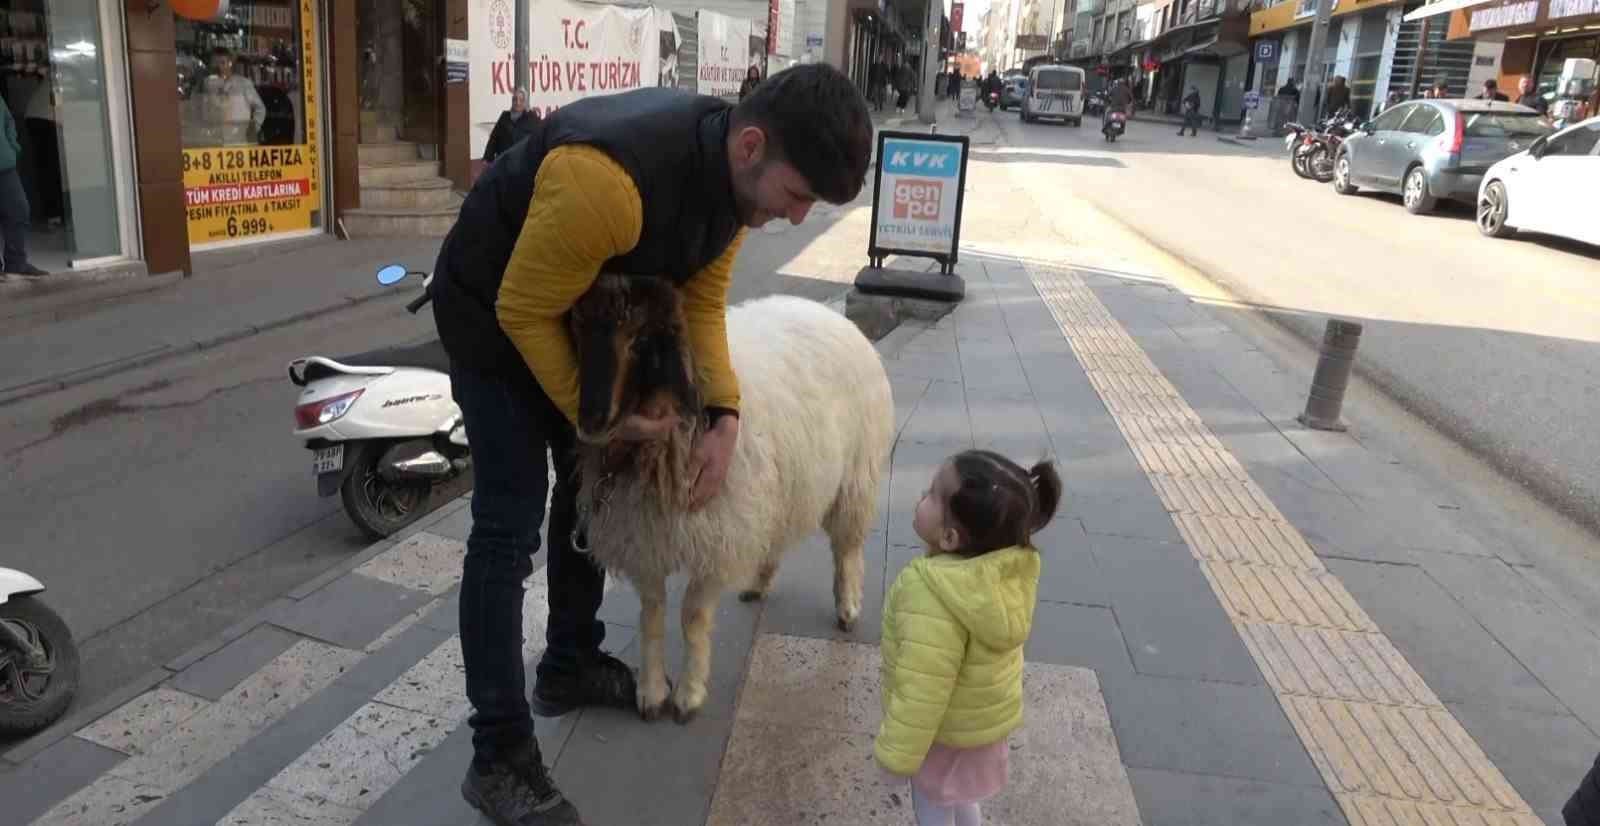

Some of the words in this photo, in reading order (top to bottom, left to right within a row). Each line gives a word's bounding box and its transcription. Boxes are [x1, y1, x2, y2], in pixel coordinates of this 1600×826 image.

[561, 19, 589, 49] T.C.
[491, 53, 562, 95] KÜTÜR
[566, 61, 586, 92] VE
[590, 56, 641, 90] TURİZM
[217, 151, 245, 170] 128
[248, 148, 303, 168] HAFIZA
[890, 151, 950, 168] KVK
[209, 173, 240, 184] AKILLI
[242, 170, 282, 182] TELEFON
[186, 187, 209, 204] TÜM
[211, 185, 241, 202] KREDİ
[243, 182, 302, 200] KARTLARINA
[895, 184, 941, 205] gen
[271, 199, 301, 212] TAKSİT
[226, 217, 267, 238] 6.999
